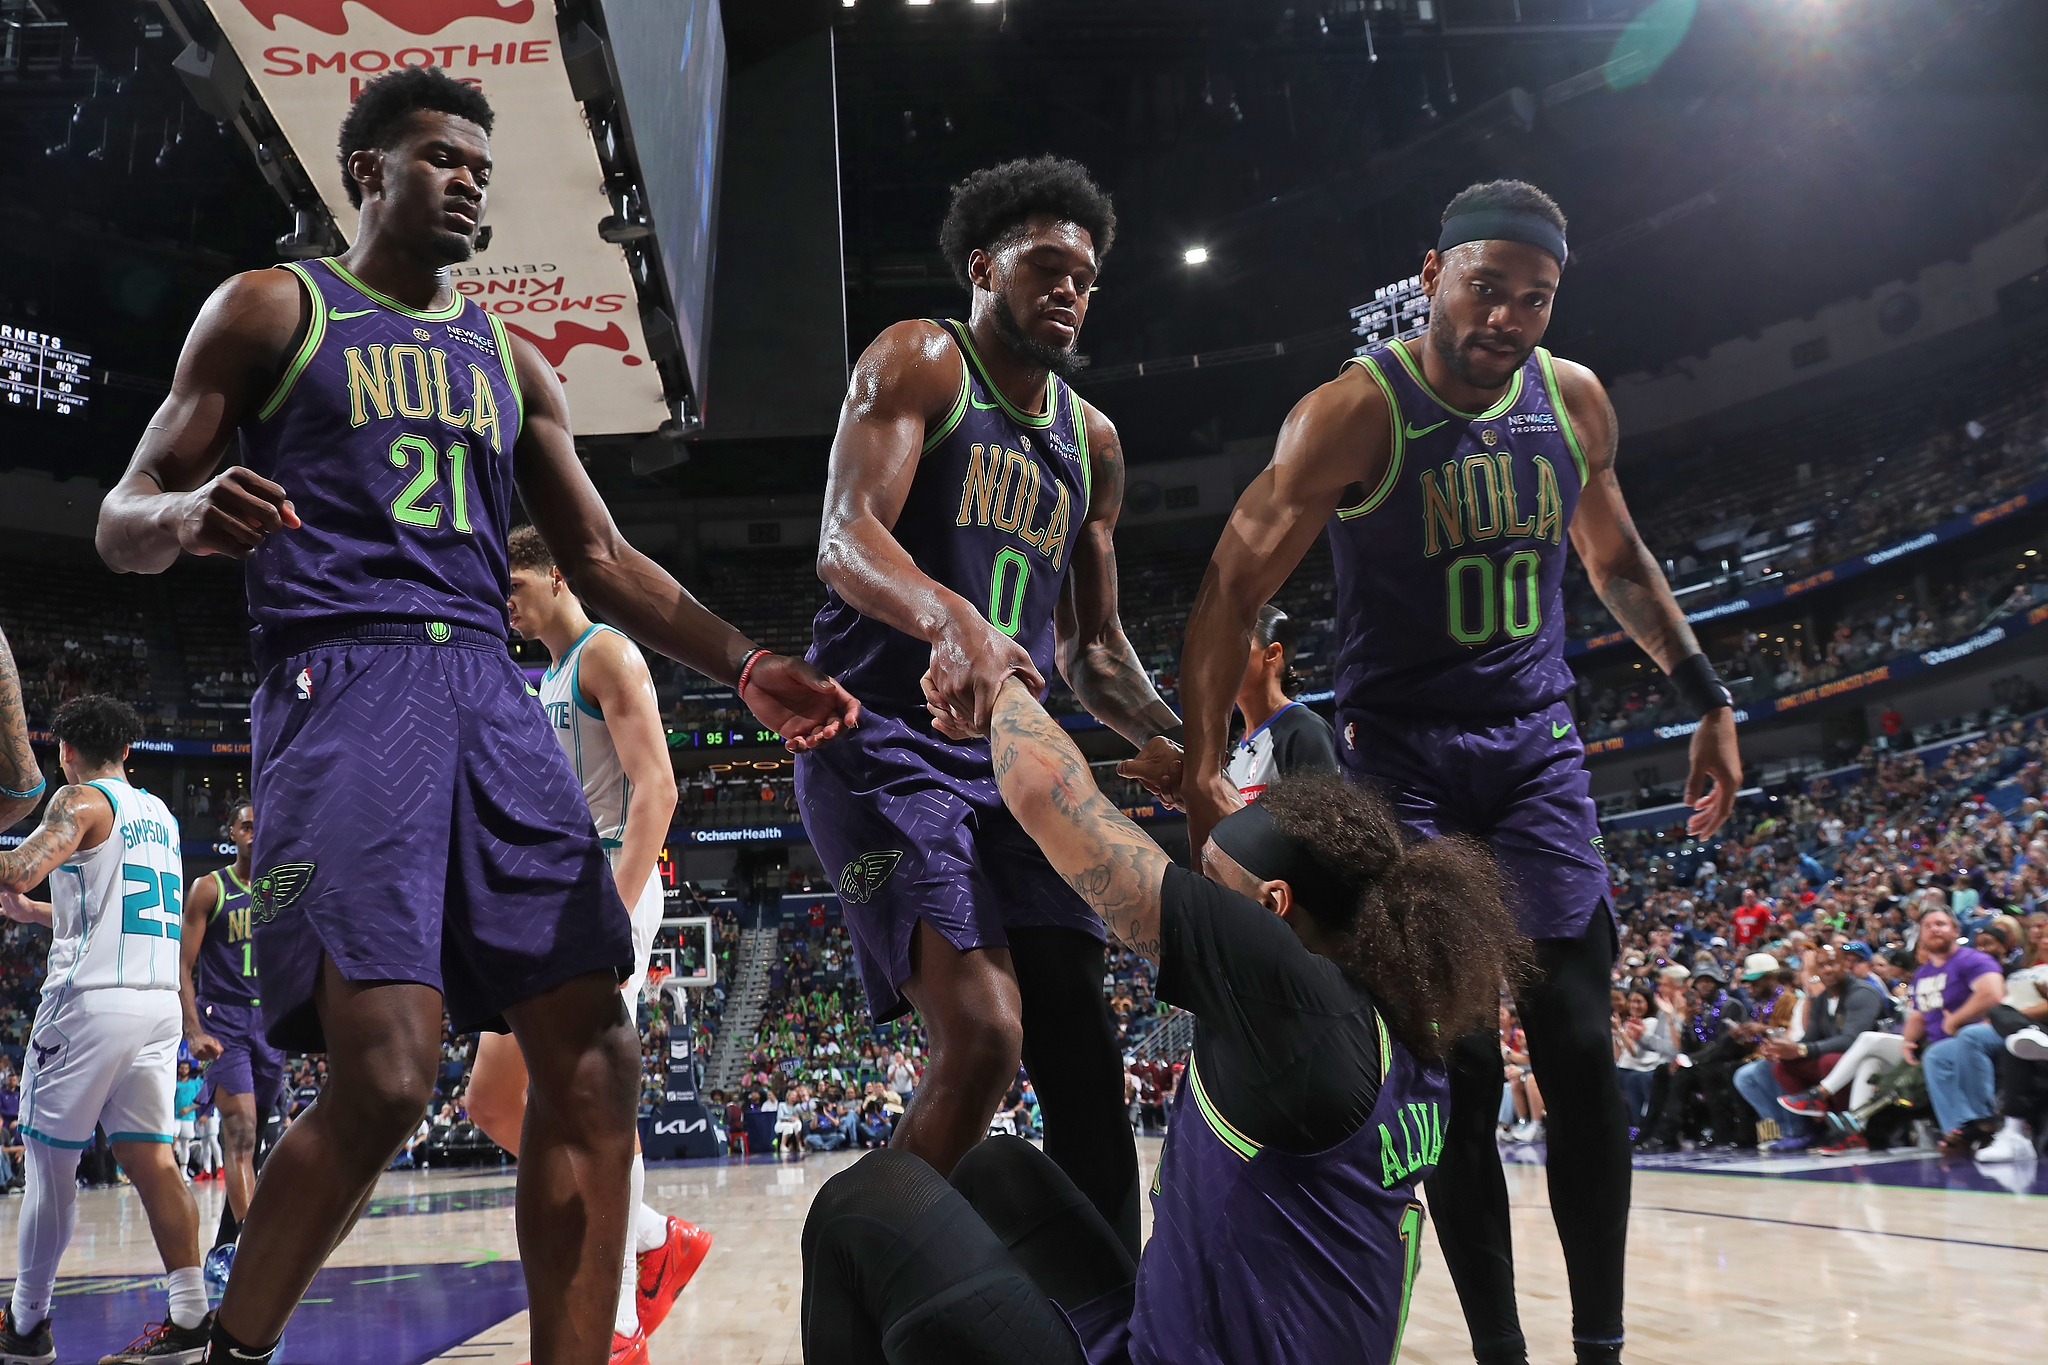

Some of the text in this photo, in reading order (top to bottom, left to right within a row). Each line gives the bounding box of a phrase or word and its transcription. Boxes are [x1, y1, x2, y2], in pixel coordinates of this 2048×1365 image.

[263, 39, 552, 76] SMOOTHIE
[450, 262, 557, 278] CENTER
[1374, 272, 1423, 300] HORN
[2, 347, 32, 363] 22/25
[448, 333, 496, 356] PRODUCTS
[7, 391, 21, 404] 16
[59, 381, 72, 393] 50
[343, 343, 502, 455] NOLA
[57, 402, 71, 415] 20
[1507, 413, 1556, 426] NEWAGE
[1510, 425, 1559, 435] PRODUCTS
[388, 432, 473, 535] 21
[956, 443, 1070, 573] NOLA
[1419, 451, 1563, 558] NOLA
[988, 545, 1032, 639] 0
[1446, 549, 1543, 646] 00
[706, 732, 723, 745] 95
[120, 818, 169, 850] SIMPSON
[696, 826, 783, 843] OchsnerHealth
[122, 862, 181, 941] 25
[1378, 1102, 1450, 1188] ALVA
